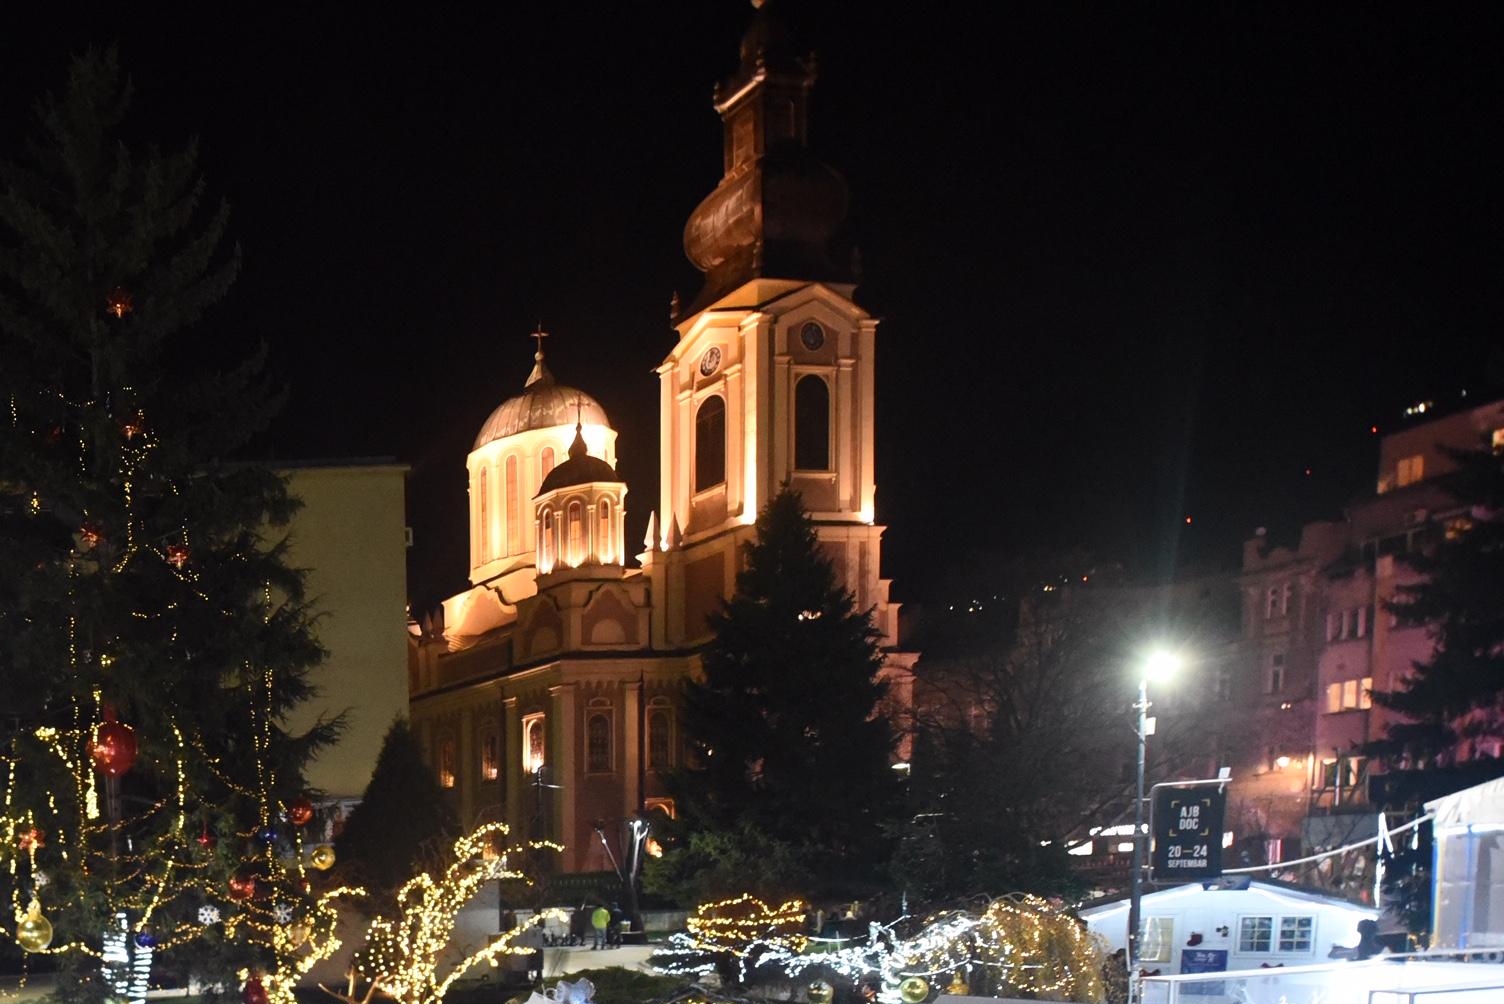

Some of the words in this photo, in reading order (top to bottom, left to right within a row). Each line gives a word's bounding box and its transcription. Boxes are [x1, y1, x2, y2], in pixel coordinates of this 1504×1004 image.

[1179, 805, 1200, 818] AJB
[1179, 818, 1199, 830] DOC
[1167, 859, 1208, 868] SEPTEMBAR
